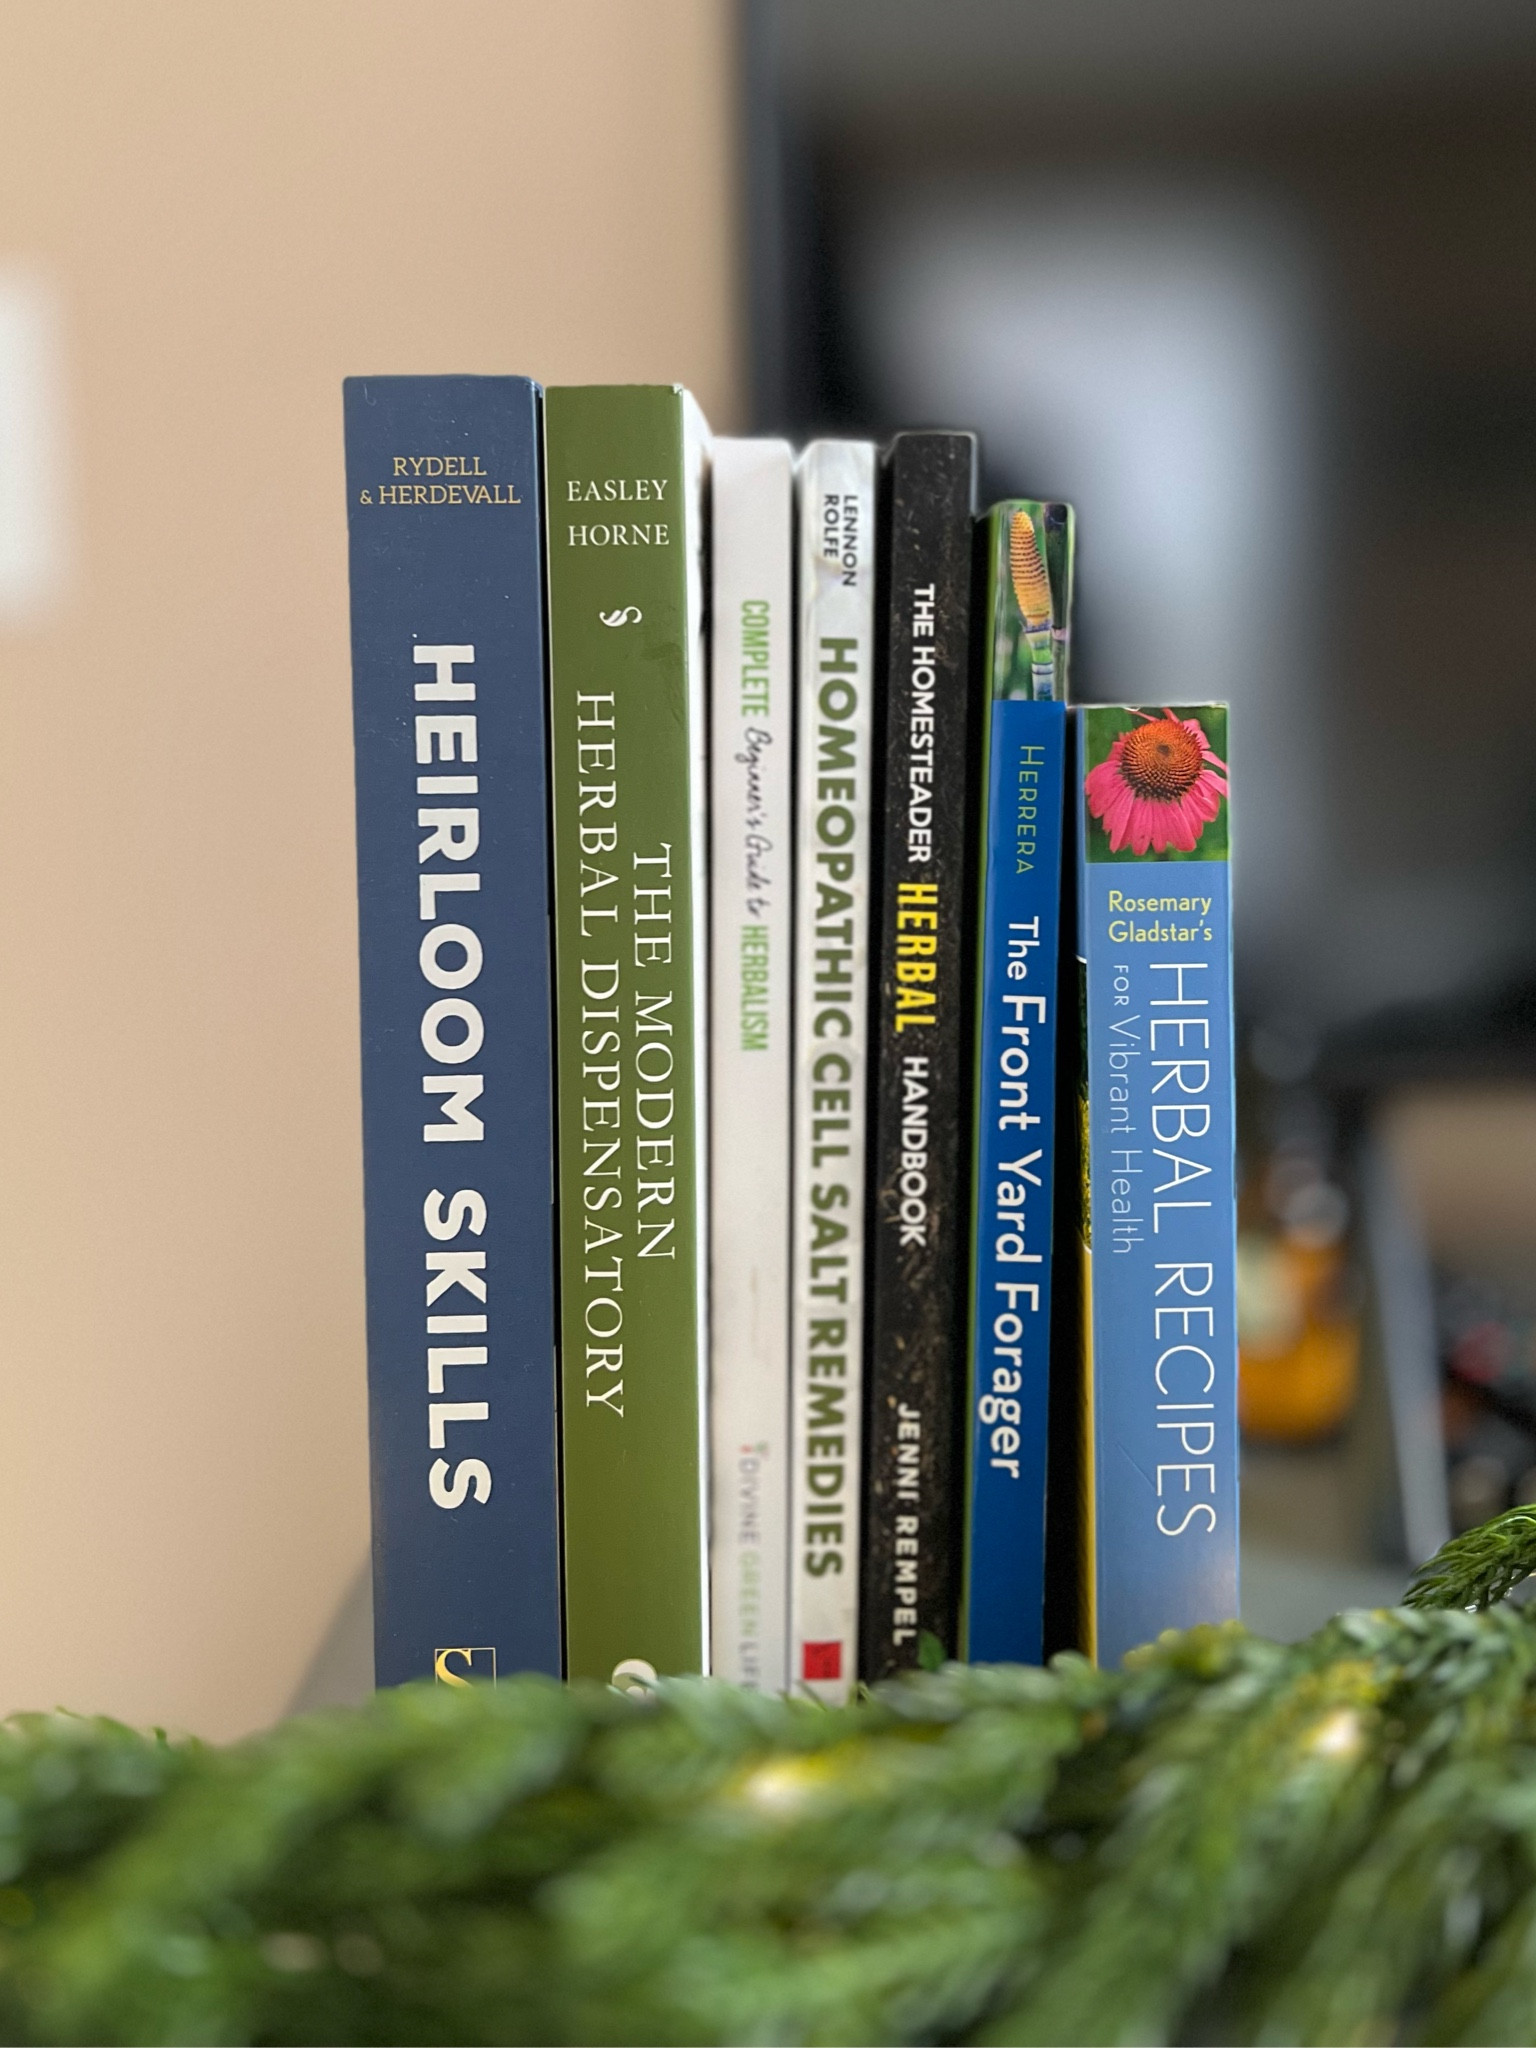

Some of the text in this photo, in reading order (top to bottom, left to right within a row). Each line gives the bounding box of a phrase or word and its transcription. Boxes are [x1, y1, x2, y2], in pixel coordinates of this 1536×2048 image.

[360, 485, 521, 504] & HERDEVALL
[393, 456, 487, 476] RYDELL
[567, 479, 668, 501] EASLEY
[823, 494, 839, 558] ROLFE
[568, 524, 670, 546] HORNE
[843, 494, 858, 587] LENNON
[740, 600, 770, 717] COMPLETE
[1015, 746, 1045, 875] HERRERA
[895, 583, 938, 1247] THE HOMESTEADER HERBAL HANDBOOK
[1109, 890, 1212, 913] Rosemary
[1109, 920, 1213, 943] Gladstar's
[633, 842, 676, 1260] THE MODERN
[740, 925, 769, 1051] HERBALISM
[413, 644, 492, 1509] HEIRLOOM SKILLS
[577, 690, 624, 1419] HERBAL DISPENSATORY
[804, 637, 858, 1578] HOMEOPATHIC CELL SALT REMEDIES
[1108, 964, 1144, 1254] FOR Vibrant Health
[978, 916, 1046, 1478] The Front Yard Forager
[1149, 962, 1216, 1536] HERBAL RECIPES
[893, 1403, 921, 1646] JENNI REMPEL
